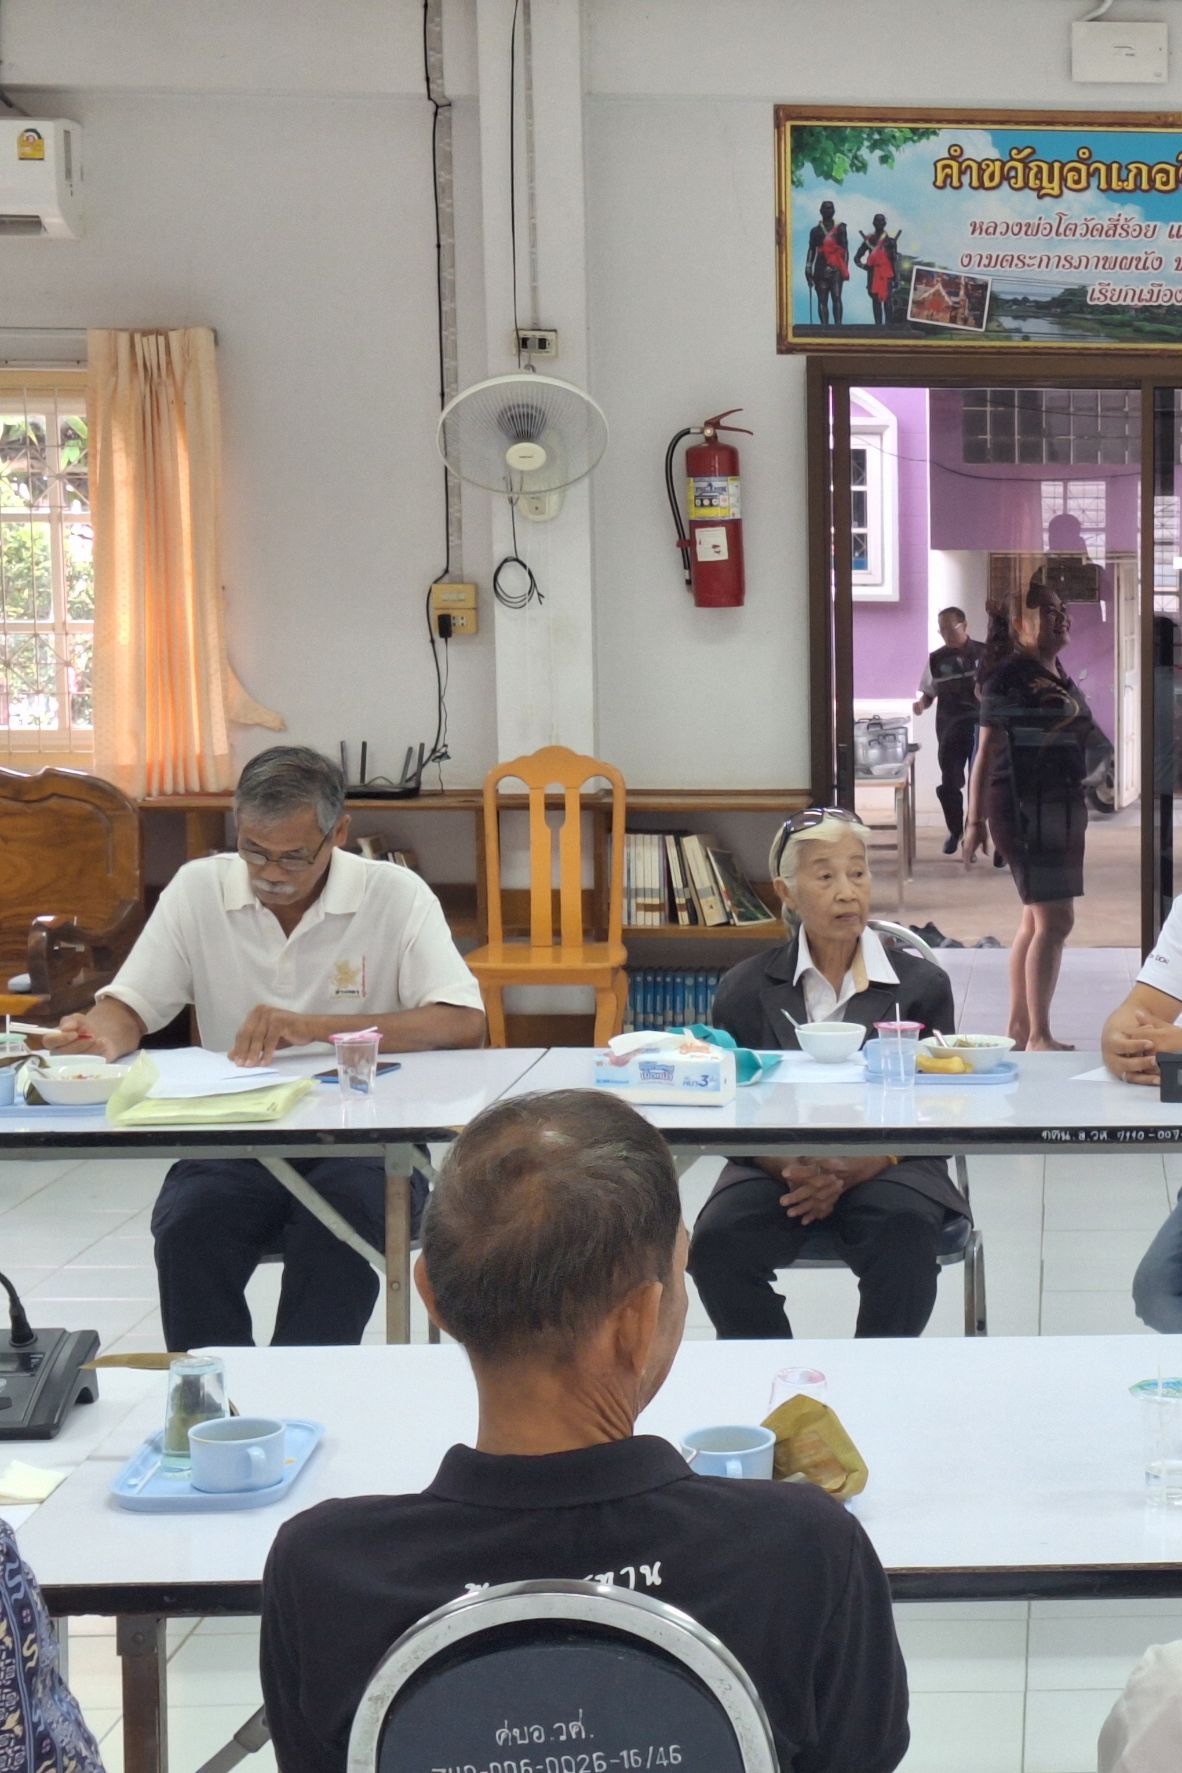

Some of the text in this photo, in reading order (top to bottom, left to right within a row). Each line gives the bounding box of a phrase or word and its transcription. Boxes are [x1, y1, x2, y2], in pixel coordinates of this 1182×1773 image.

[969, 213, 1157, 240] หลวงพ่อโตวัดสี่ร้อย
[960, 249, 1163, 271] งามตระการภาพผนัง
